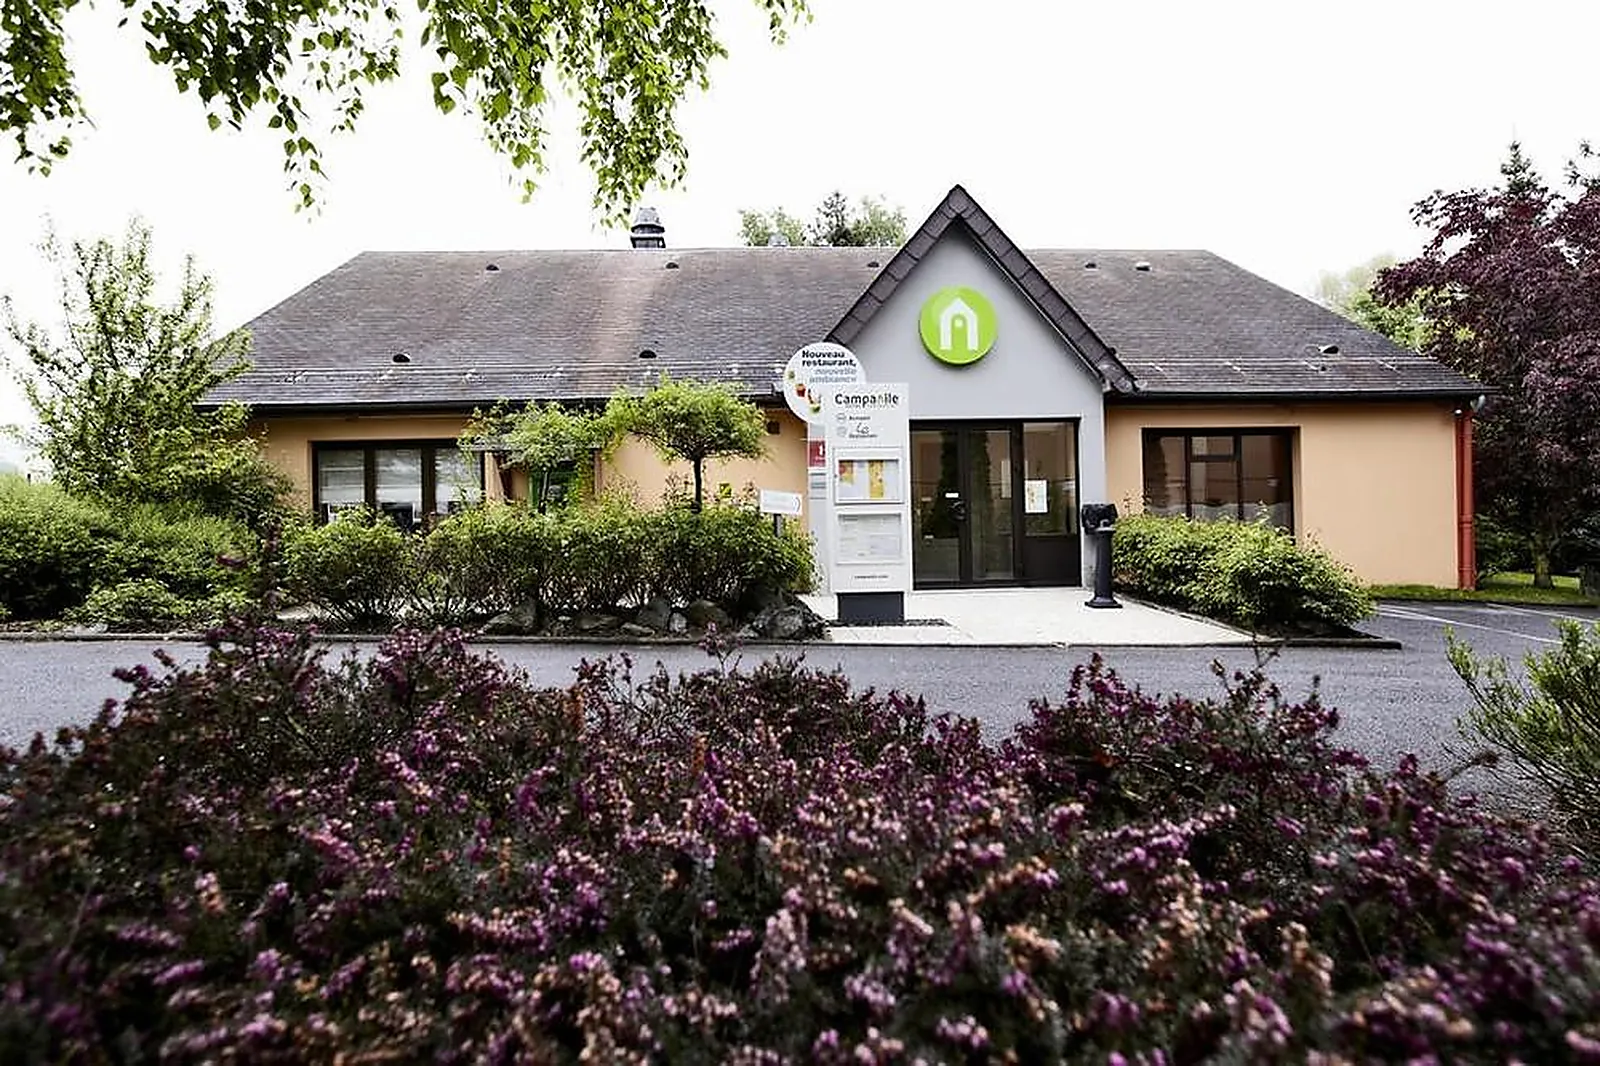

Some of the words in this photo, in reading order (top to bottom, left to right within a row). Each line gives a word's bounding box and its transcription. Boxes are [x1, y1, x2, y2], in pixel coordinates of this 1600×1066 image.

[802, 350, 845, 358] Nouveau
[802, 359, 857, 367] restaurant,
[835, 393, 899, 408] Campanile
